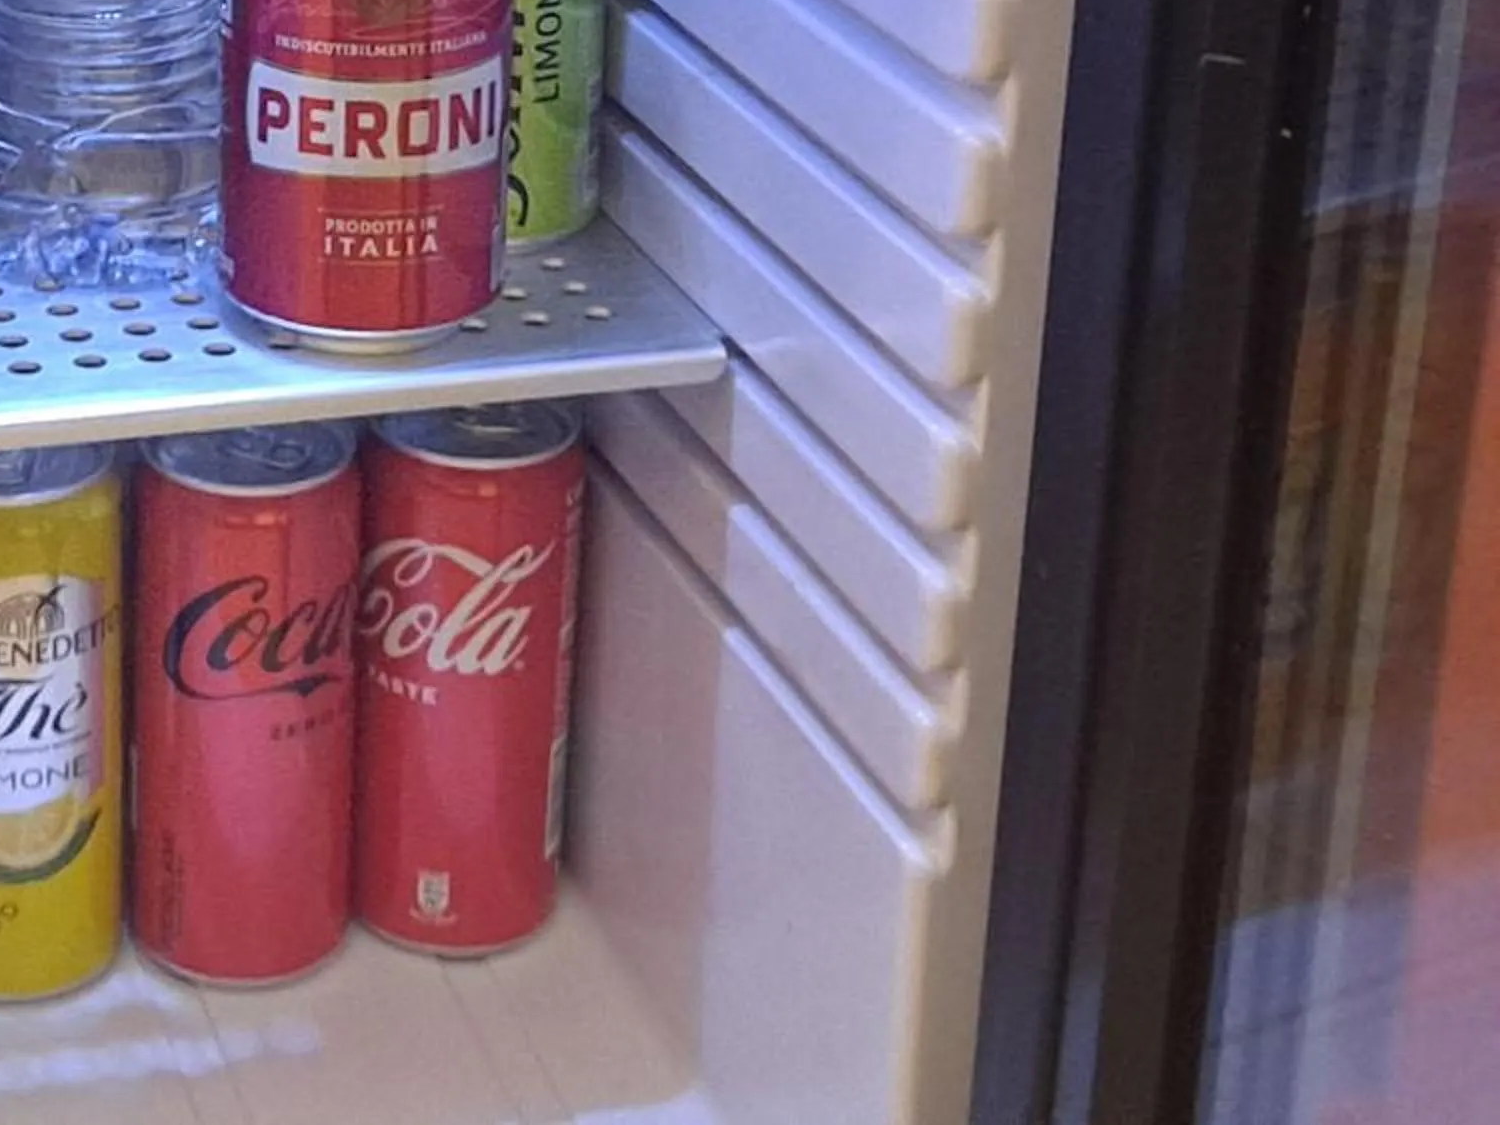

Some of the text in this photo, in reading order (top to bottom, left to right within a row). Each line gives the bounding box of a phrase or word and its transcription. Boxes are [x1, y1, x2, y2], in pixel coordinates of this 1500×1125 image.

[257, 79, 497, 161] PERONI
[324, 217, 416, 235] PRODOTTA
[323, 233, 439, 257] ITALIA
